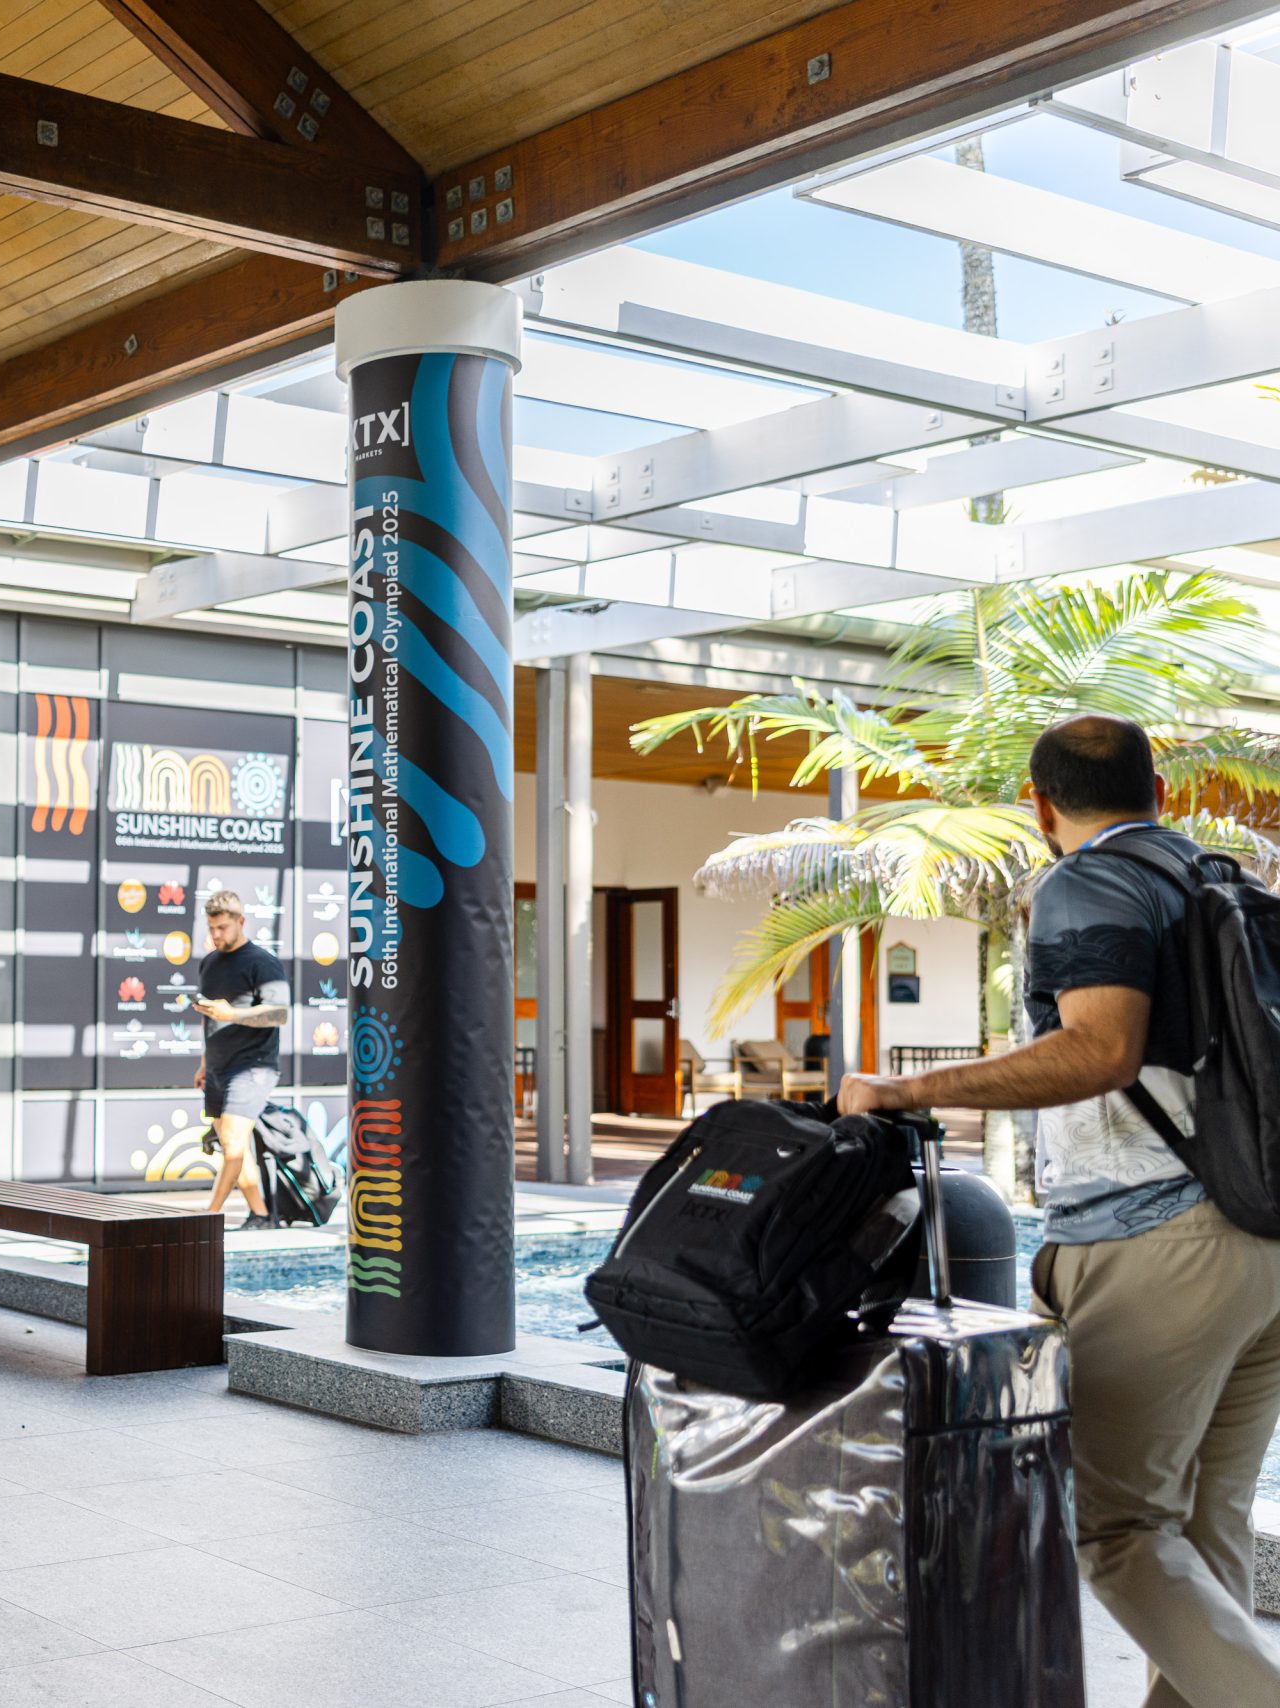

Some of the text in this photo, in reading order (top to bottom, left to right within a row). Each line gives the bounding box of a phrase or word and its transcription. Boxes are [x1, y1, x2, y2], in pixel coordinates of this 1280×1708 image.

[116, 813, 285, 843] SUNSHINE COAST
[229, 841, 264, 854] Olympiad
[350, 501, 375, 989] SUNSHINE COAST
[381, 490, 402, 989] 66th International Mathematical Olympiad 2025
